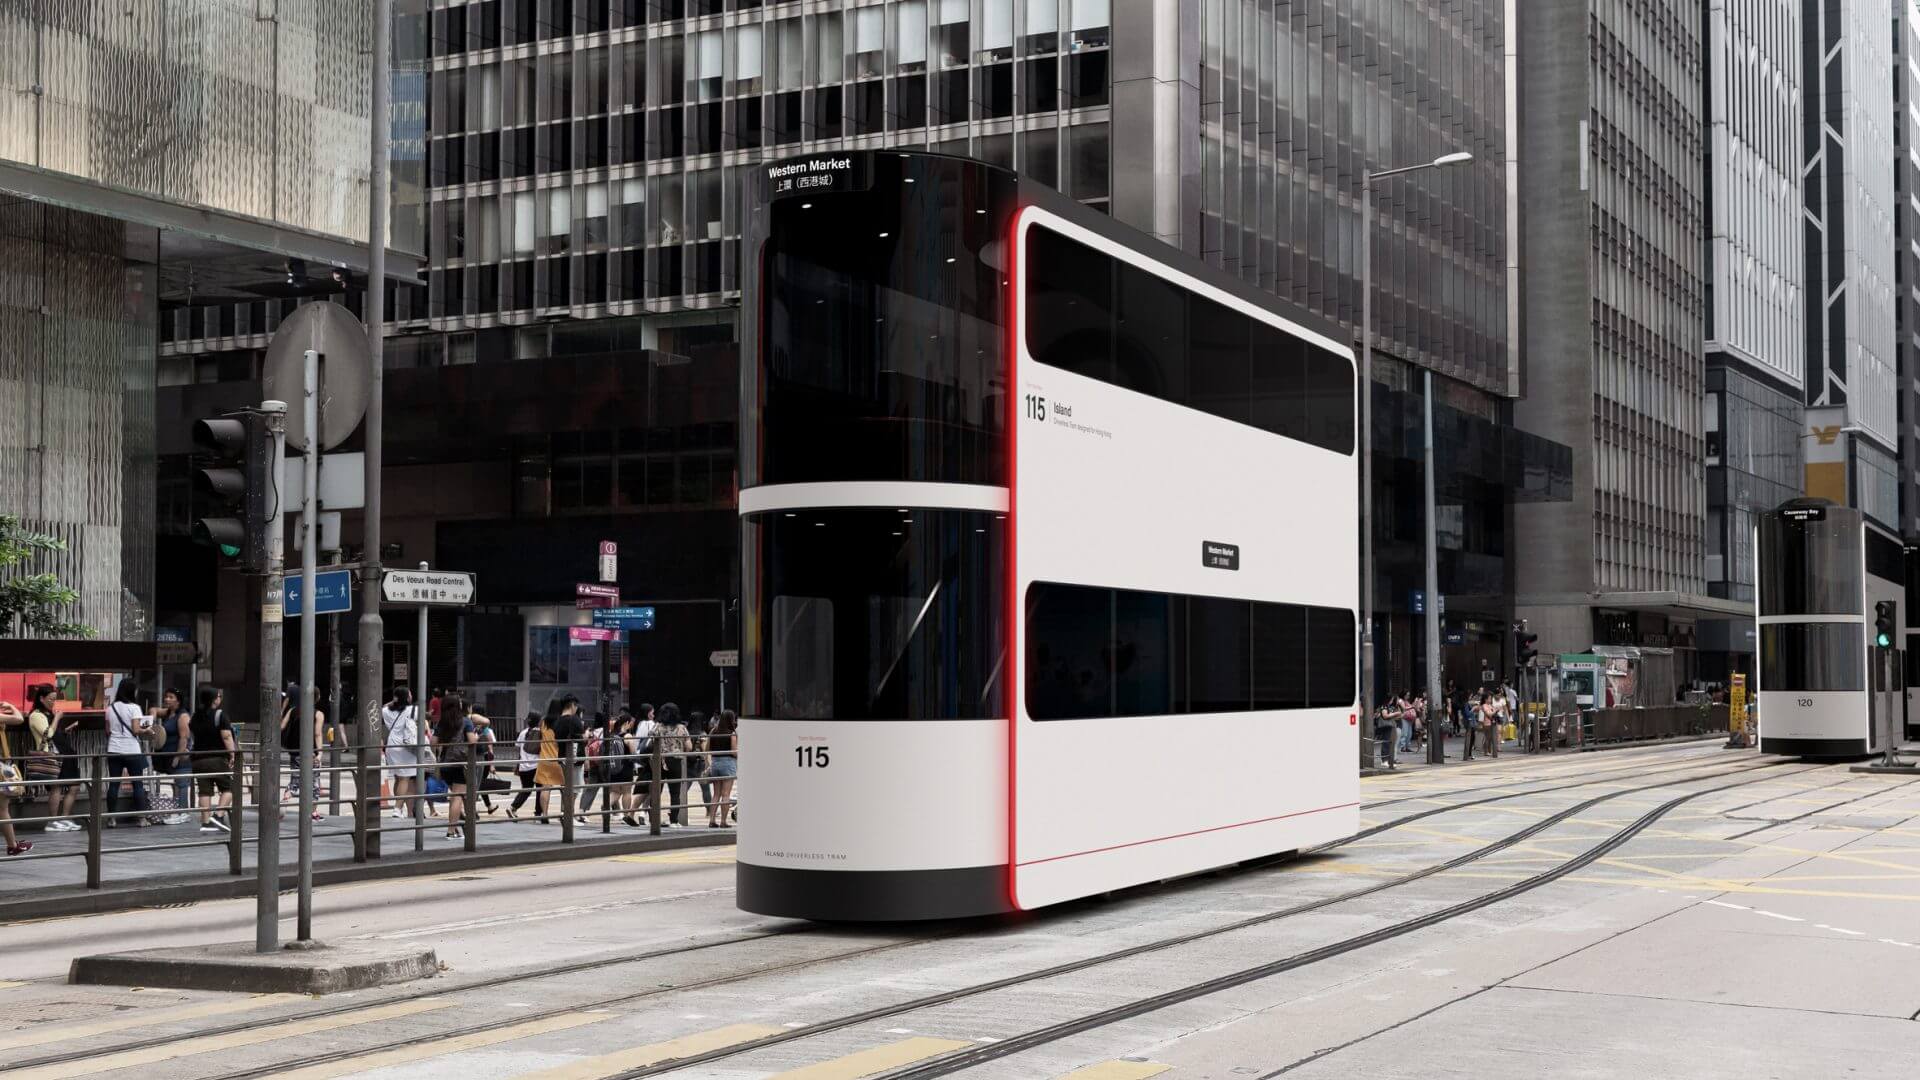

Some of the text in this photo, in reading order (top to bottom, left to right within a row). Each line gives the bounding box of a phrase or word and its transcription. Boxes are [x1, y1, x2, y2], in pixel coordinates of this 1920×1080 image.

[768, 158, 851, 179] Western Market
[1025, 393, 1046, 422] 115
[1053, 402, 1072, 417] Island
[392, 575, 465, 586] Des Voeux Road Central
[1797, 699, 1813, 707] 120
[795, 746, 830, 768] 115
